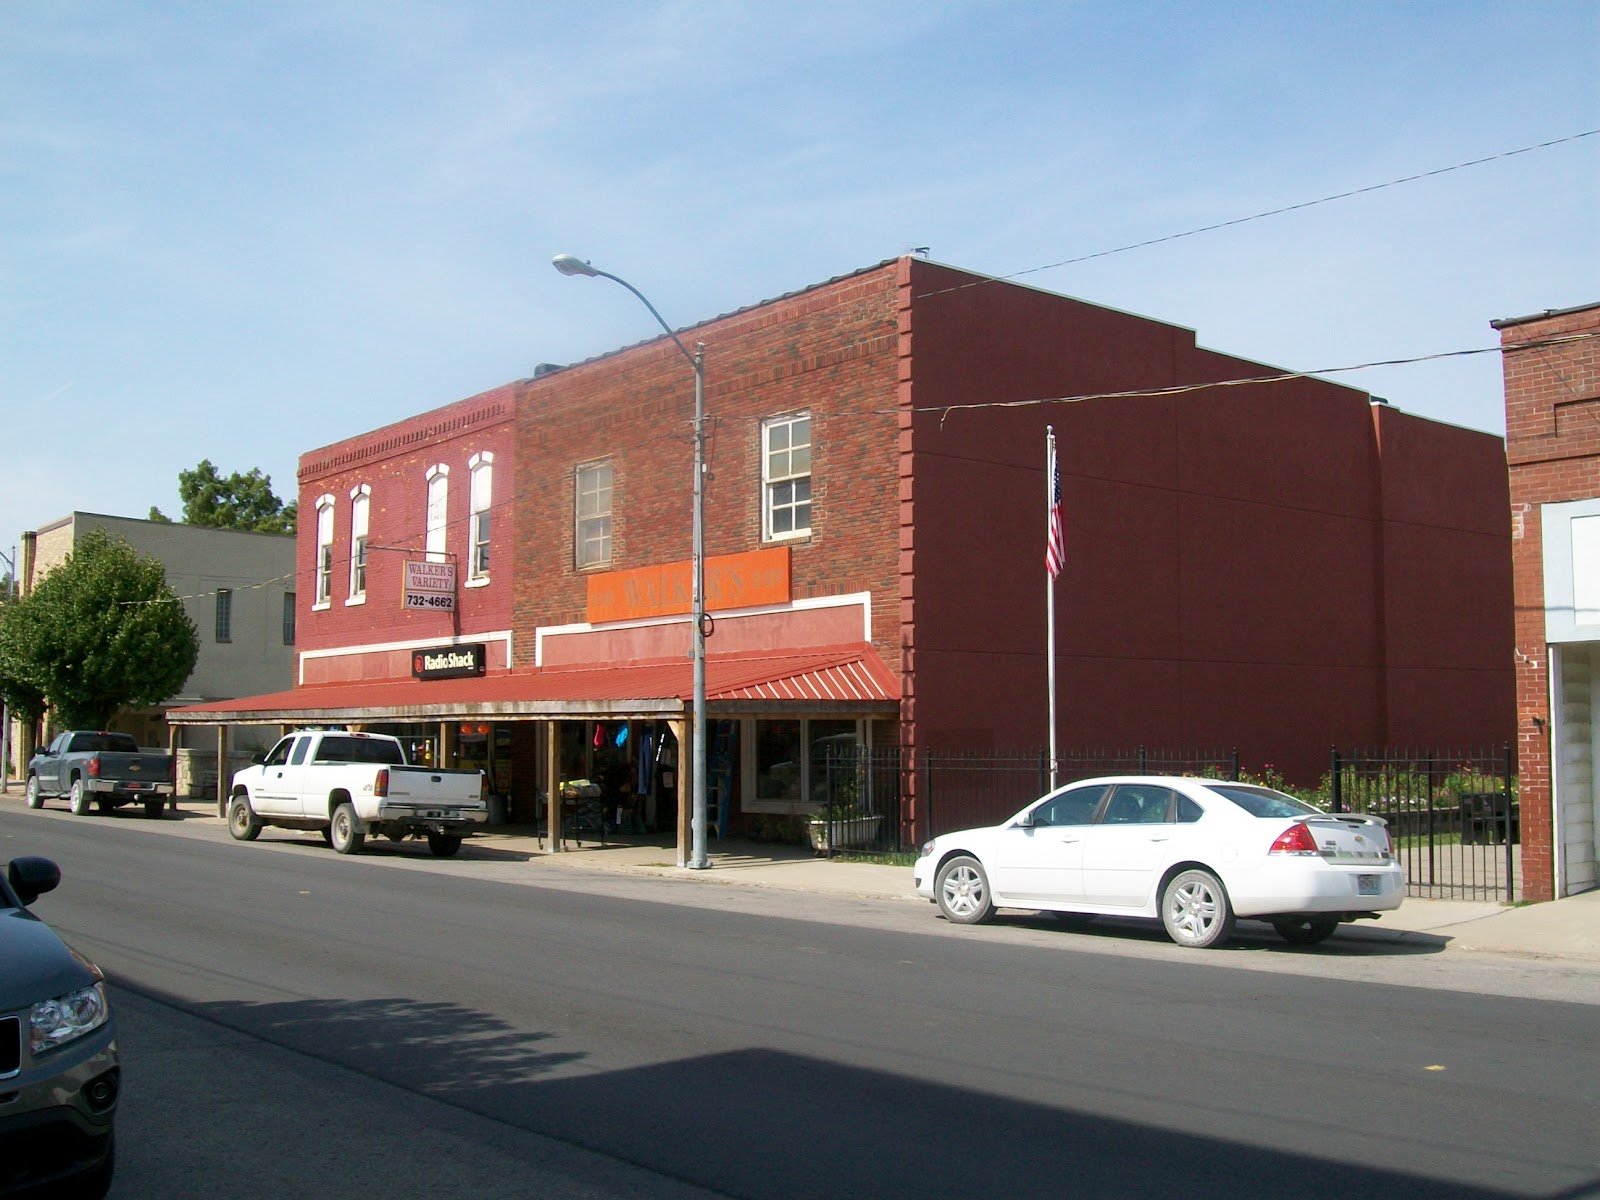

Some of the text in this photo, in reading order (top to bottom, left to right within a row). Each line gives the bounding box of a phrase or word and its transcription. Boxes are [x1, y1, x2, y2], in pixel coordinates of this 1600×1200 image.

[409, 564, 453, 577] WALKER'S
[412, 576, 450, 589] VARIETY
[624, 563, 744, 609] WALKR'S
[407, 595, 452, 607] 732-4662
